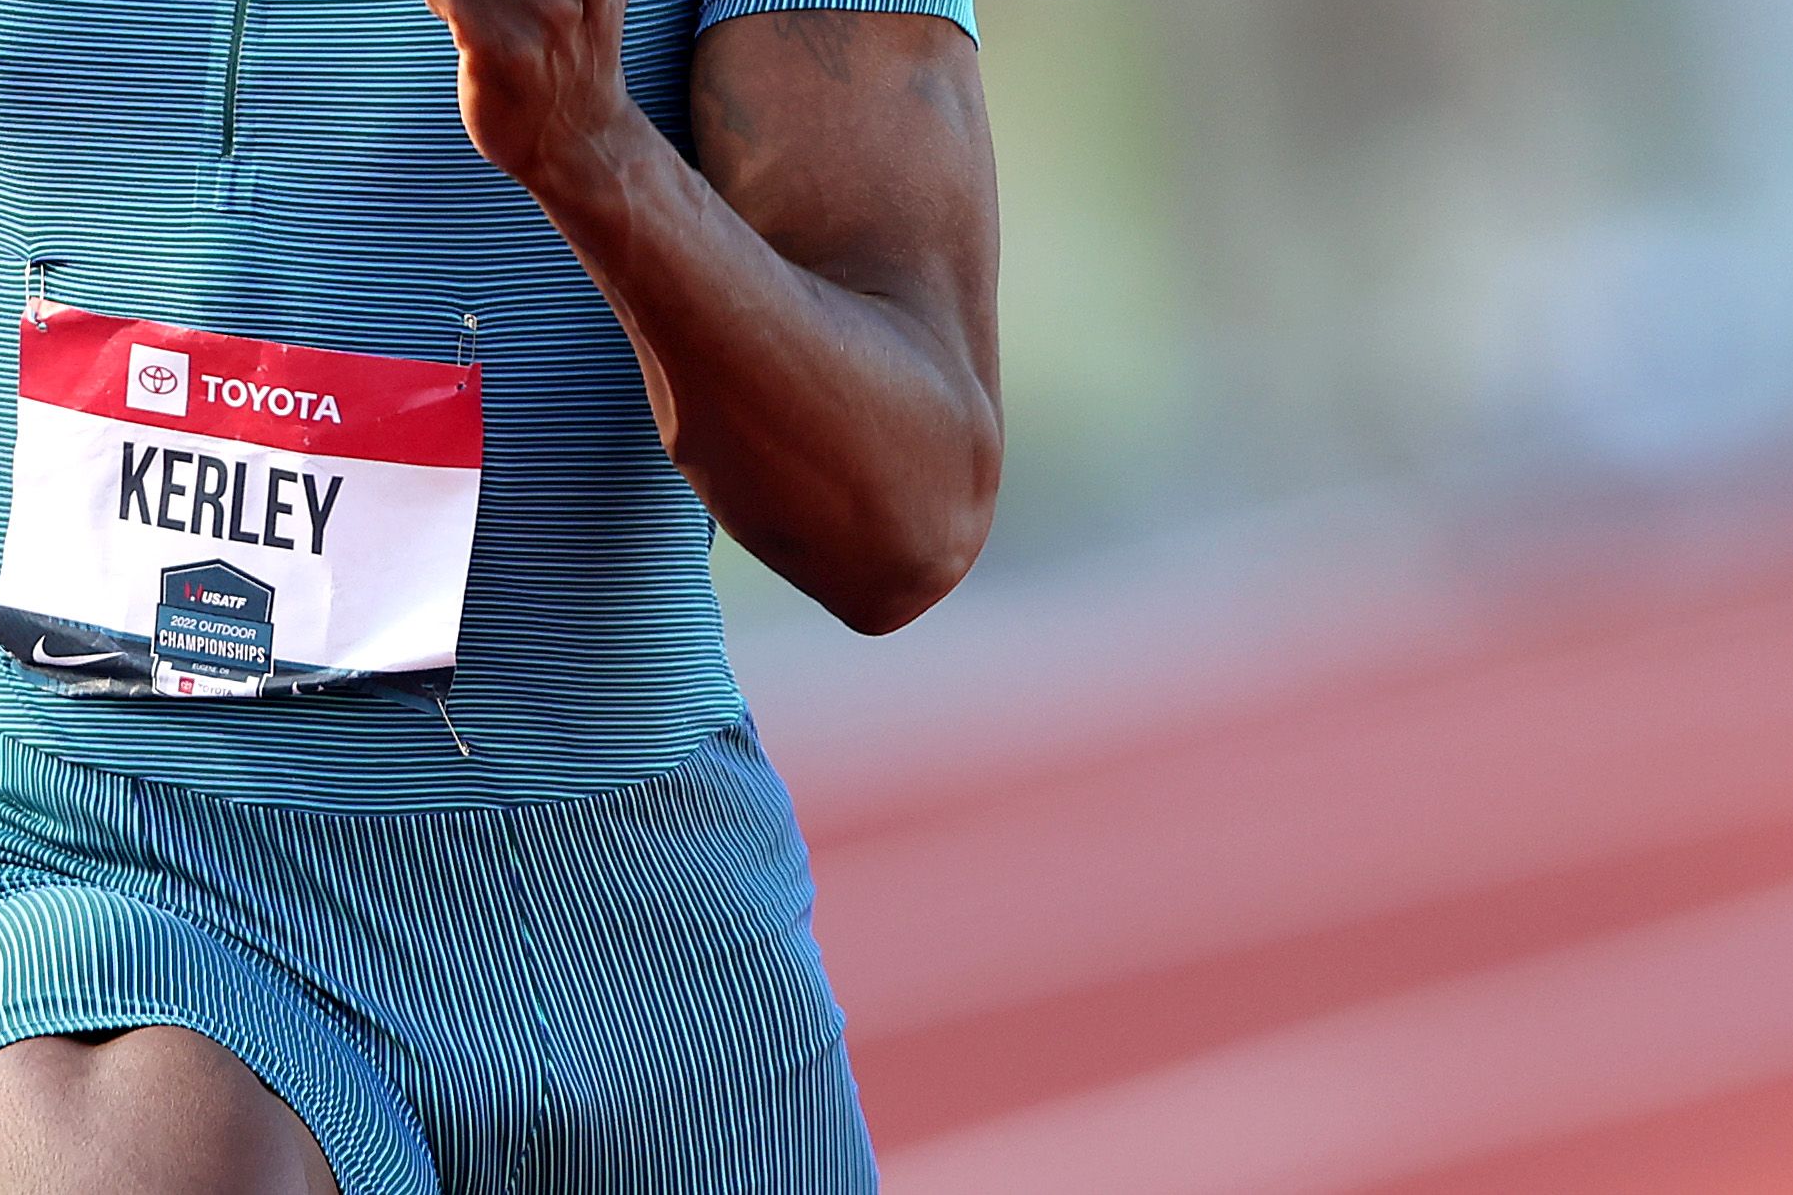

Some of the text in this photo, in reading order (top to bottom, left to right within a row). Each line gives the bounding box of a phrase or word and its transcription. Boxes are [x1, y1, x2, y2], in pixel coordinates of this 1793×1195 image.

[201, 374, 343, 424] TOYOTA
[119, 441, 344, 556] KERLEY
[202, 591, 247, 609] USATF
[171, 615, 257, 640] 2022 OUTDOOR
[159, 629, 266, 664] CHAMPIONSHIPS
[198, 683, 233, 696] TOYOTA
